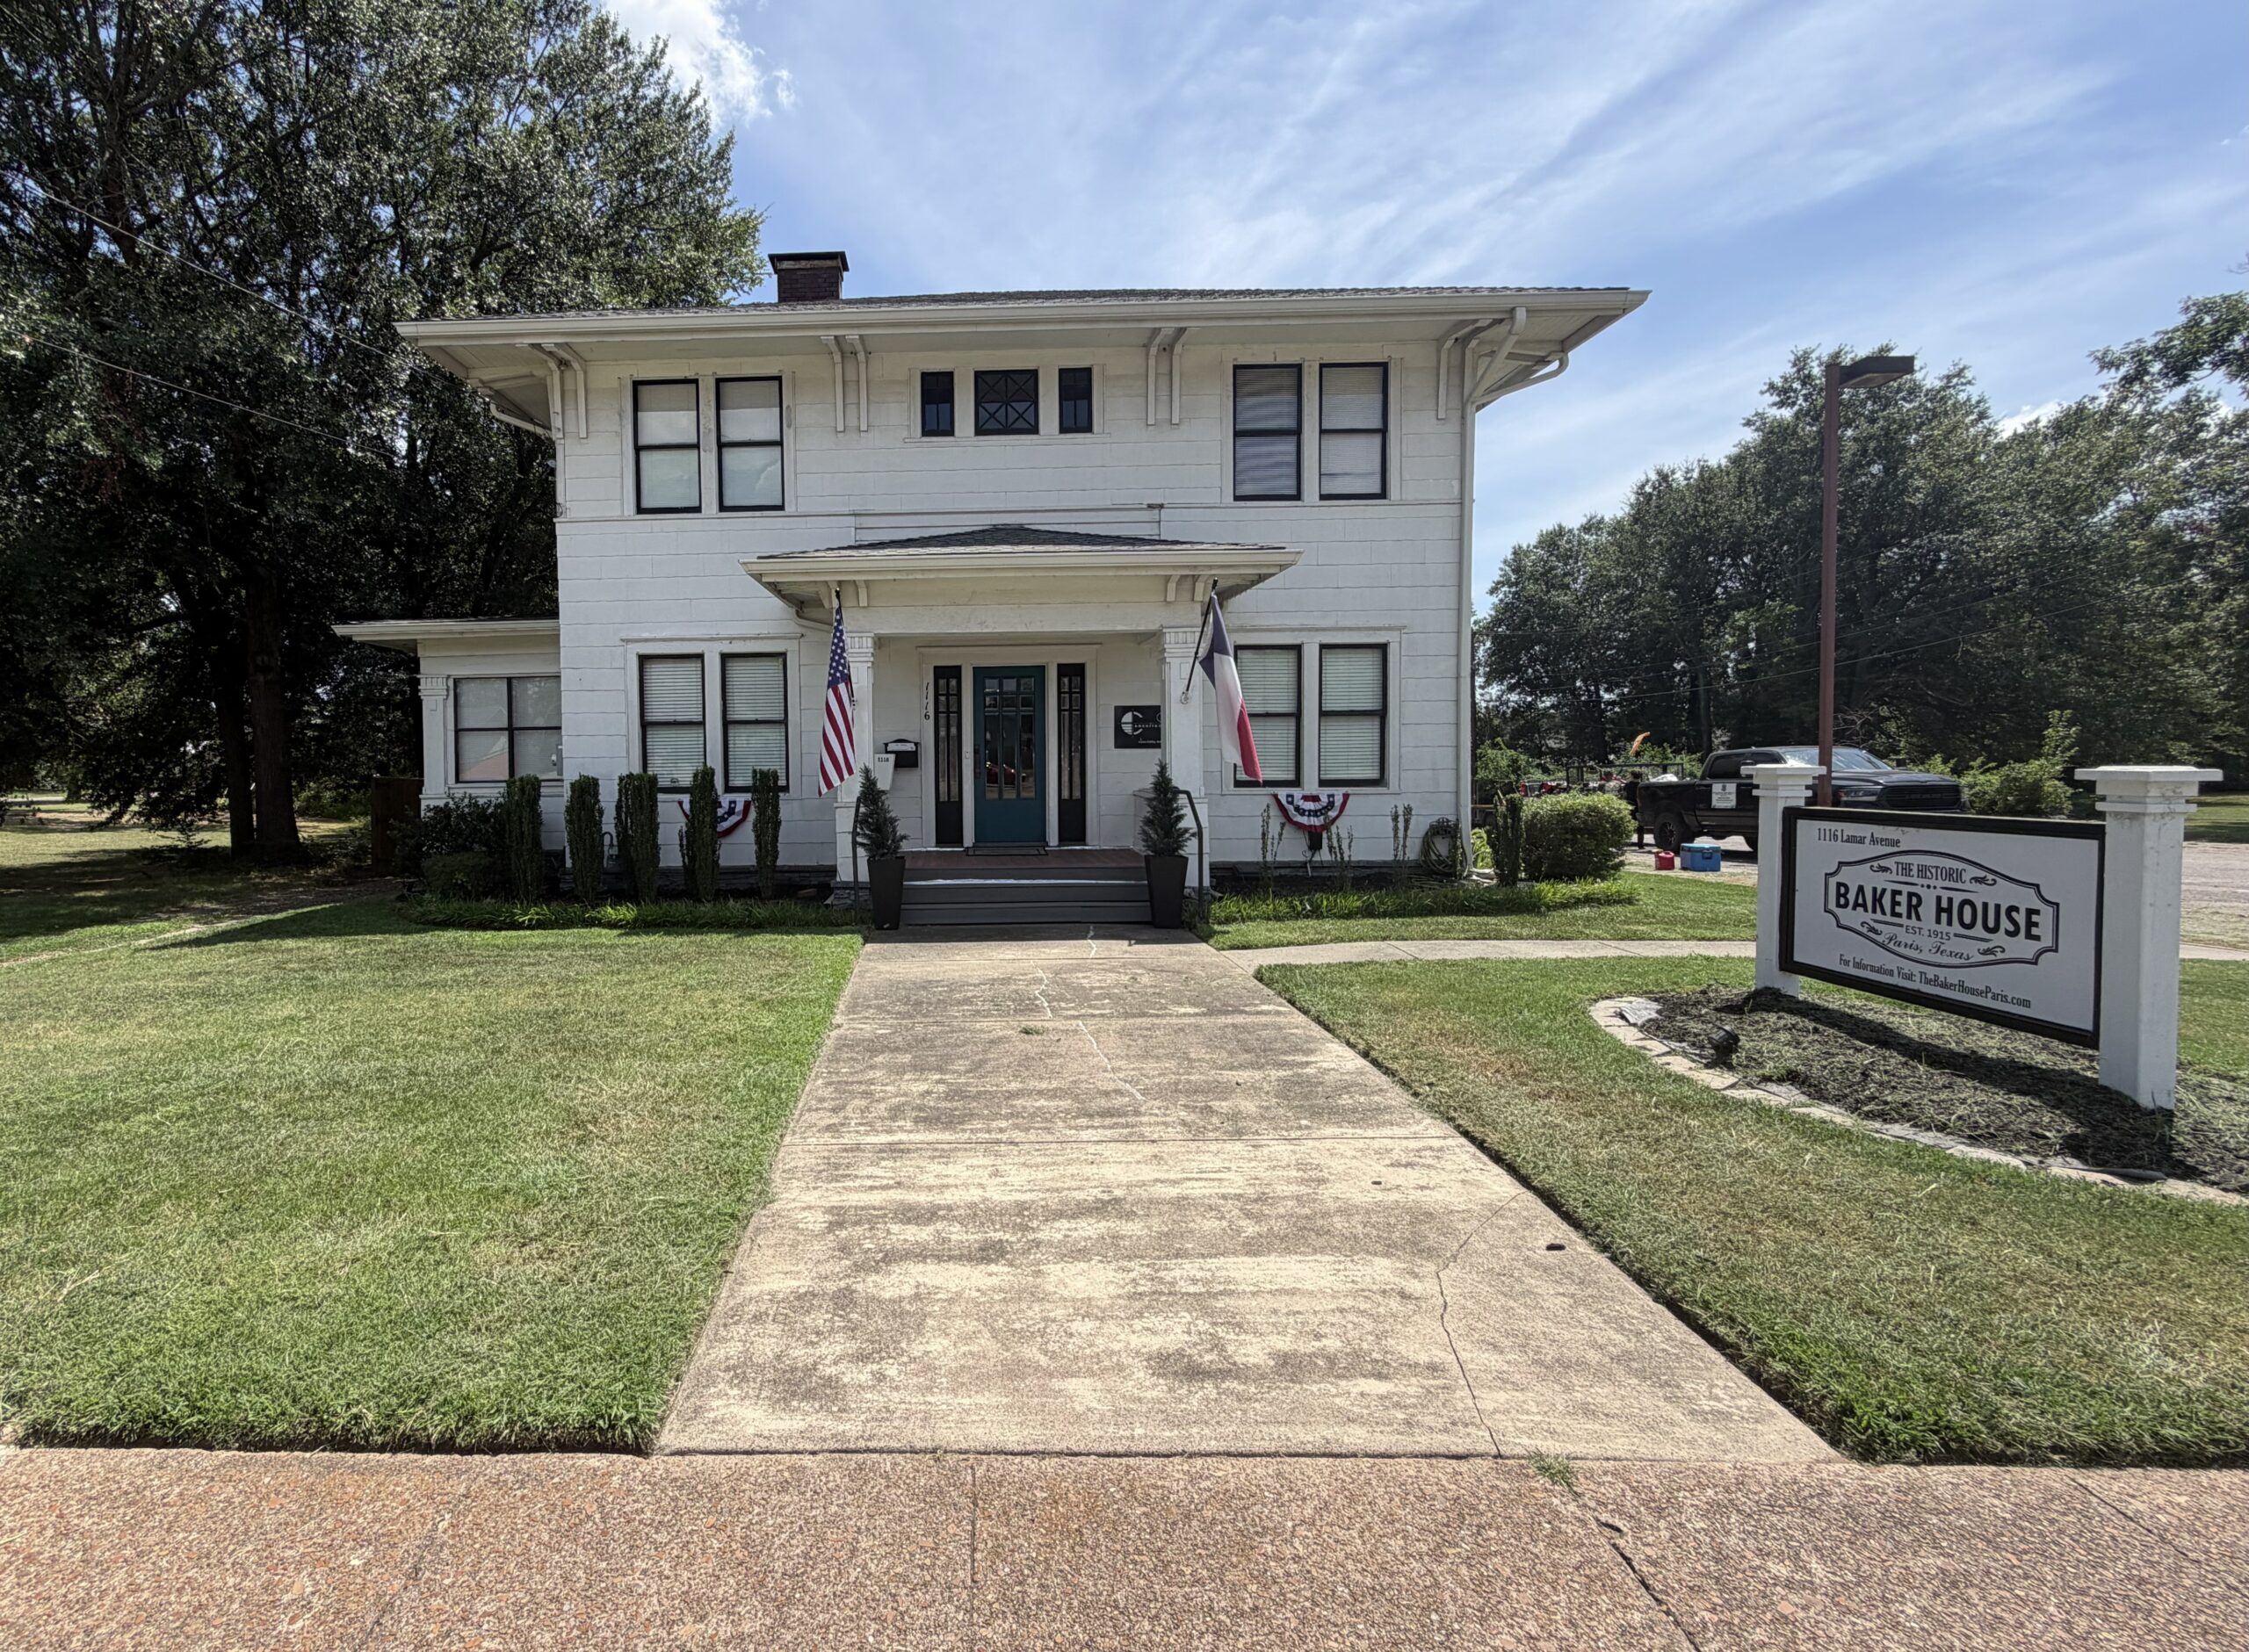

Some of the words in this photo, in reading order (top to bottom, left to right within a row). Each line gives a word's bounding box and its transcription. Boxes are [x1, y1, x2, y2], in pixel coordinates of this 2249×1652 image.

[1817, 827, 1839, 843] 1116
[1840, 829, 1867, 845] Lamar
[1869, 832, 1901, 848] Avenue
[1894, 861, 1914, 877] THE
[1917, 863, 1966, 884] HISTORIC
[1835, 881, 1923, 922] BAKER
[1934, 894, 2042, 942] HOUSE
[1905, 925, 1925, 937] EST.
[1927, 929, 1951, 941] 1915
[1882, 932, 1923, 955] Paris,
[1928, 941, 1975, 962] Texas
[1839, 954, 1851, 967] For
[1853, 956, 1894, 977] Information
[1897, 966, 1917, 983] Visit:
[1918, 970, 2032, 1009] TheBakerHouseParis.com
